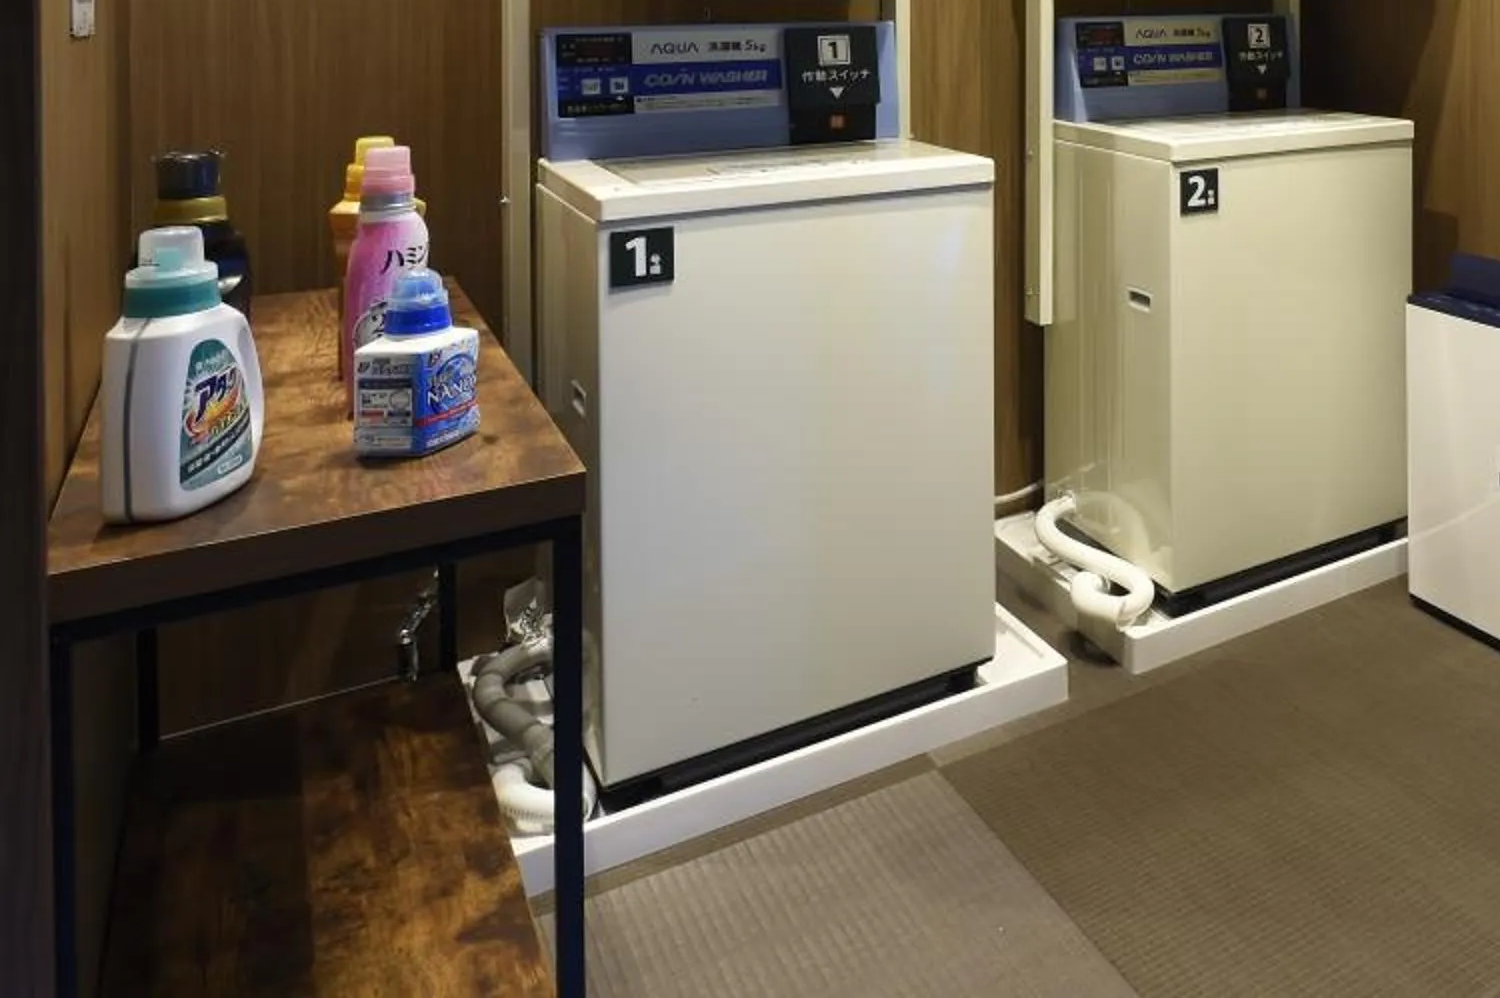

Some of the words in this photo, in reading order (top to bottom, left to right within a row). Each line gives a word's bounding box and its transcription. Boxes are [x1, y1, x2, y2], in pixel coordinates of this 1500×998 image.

[1255, 28, 1265, 43] 2
[651, 44, 699, 55] AQUA
[828, 42, 838, 59] 1
